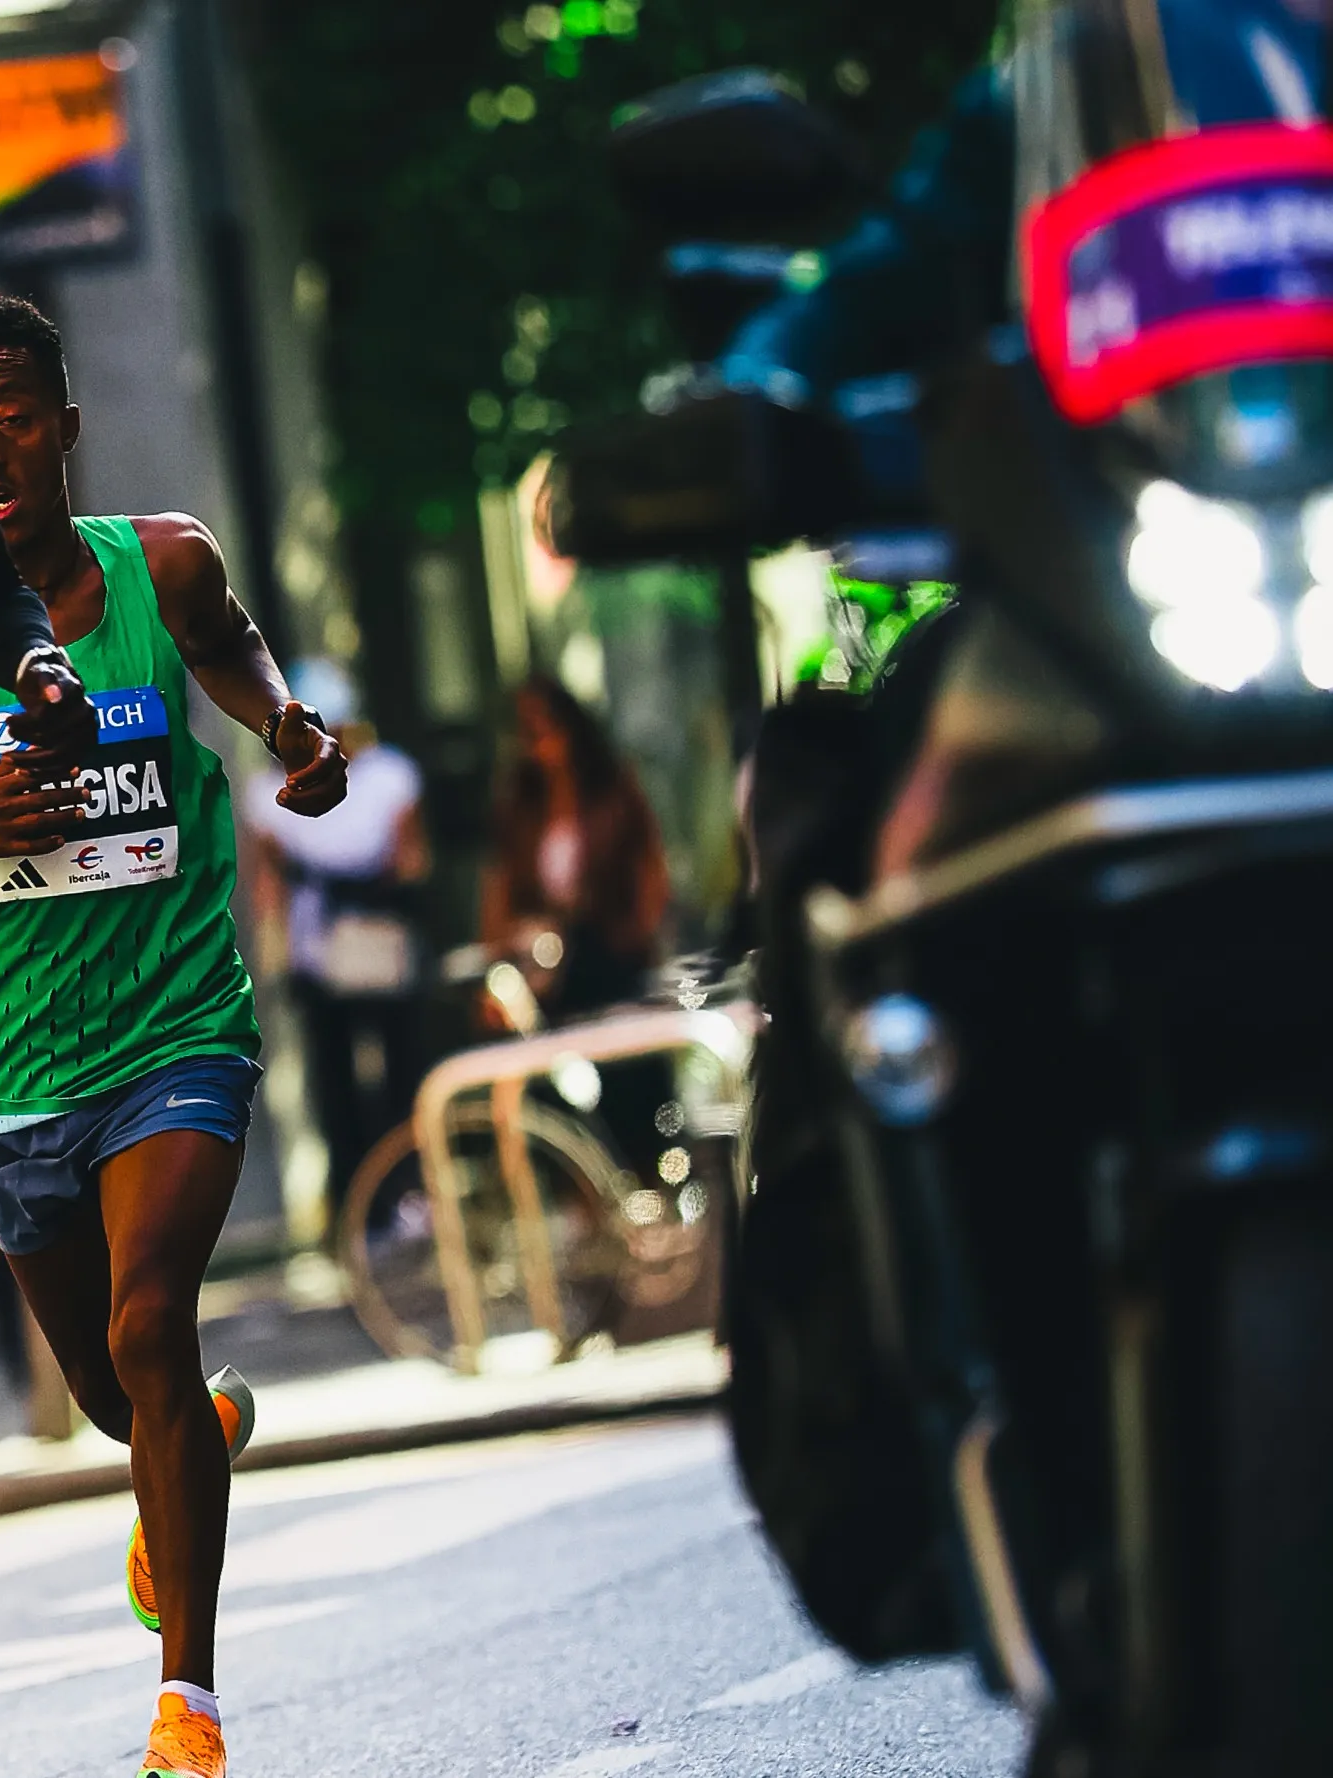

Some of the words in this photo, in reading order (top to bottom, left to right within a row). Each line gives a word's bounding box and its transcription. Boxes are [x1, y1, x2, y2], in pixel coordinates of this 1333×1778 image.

[96, 702, 145, 730] ICH
[24, 760, 167, 820] GISA
[68, 870, 111, 884] Ibercaja
